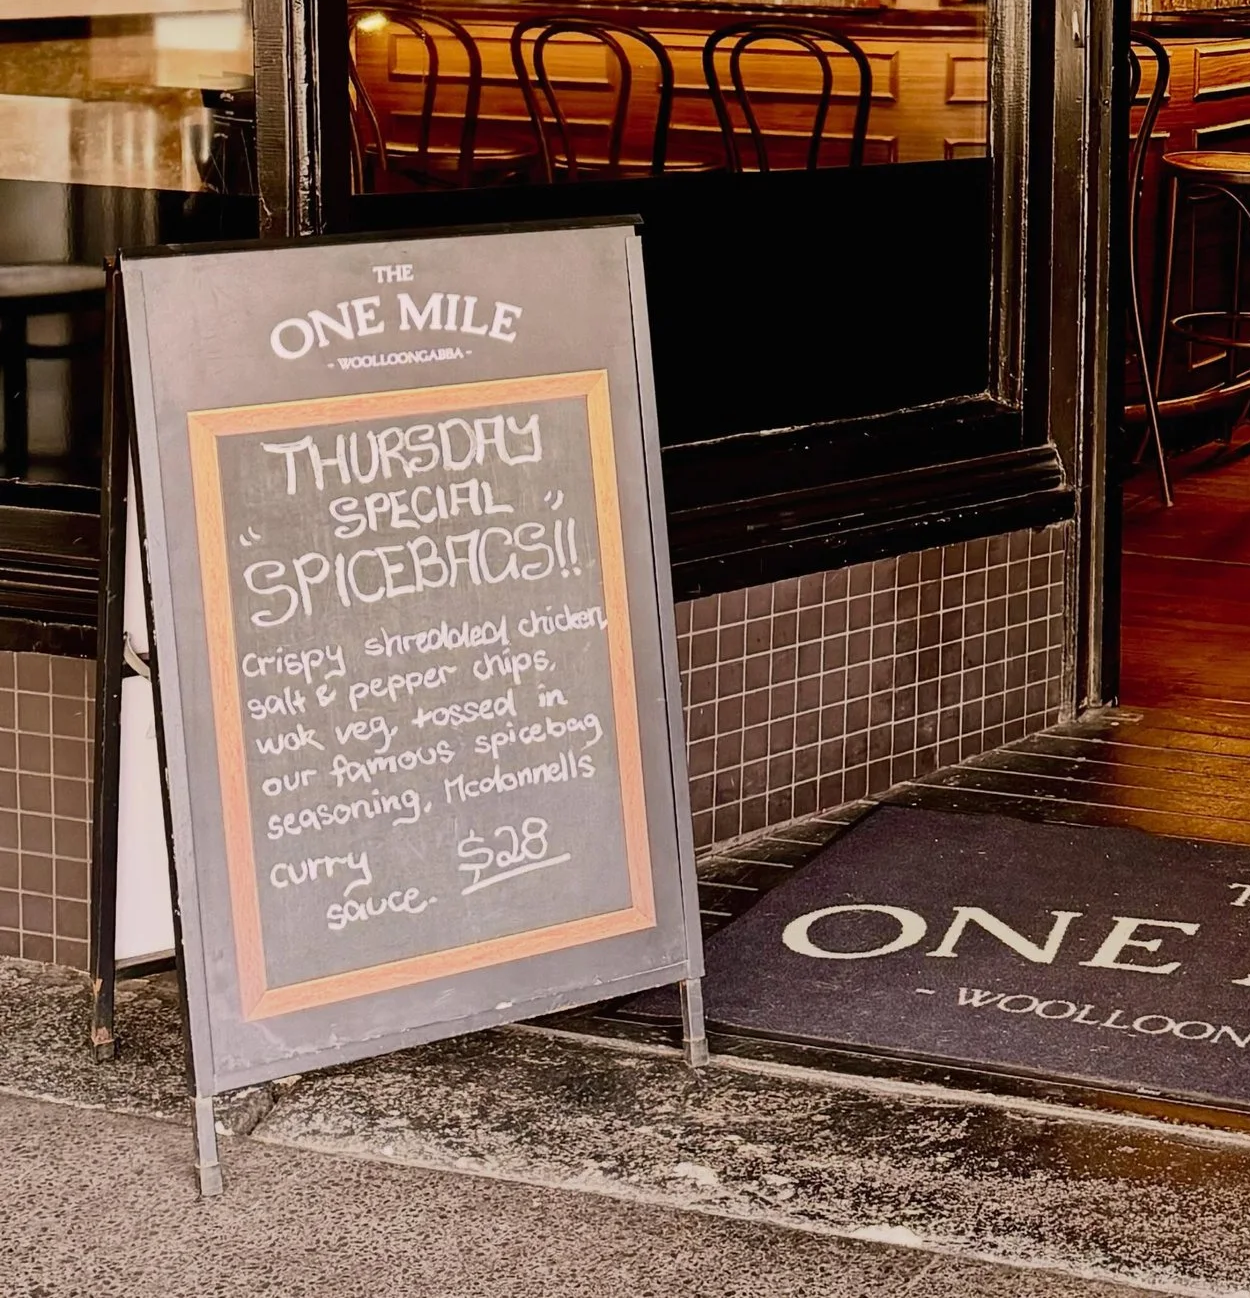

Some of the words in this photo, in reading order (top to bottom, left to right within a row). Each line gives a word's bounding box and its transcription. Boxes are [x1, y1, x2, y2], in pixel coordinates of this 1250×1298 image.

[373, 264, 414, 284] THE
[269, 293, 385, 360] ONE
[398, 292, 524, 343] MILE
[337, 347, 464, 370] WOOLLOONGABBA
[260, 413, 540, 495] THURSDAY
[329, 478, 513, 540] SPECIAL
[365, 620, 508, 658] shredded
[248, 693, 306, 721] salt
[315, 688, 337, 707] &
[348, 663, 456, 713] pepper
[256, 726, 324, 755] wok
[411, 689, 516, 728] tossed
[538, 685, 568, 709] in
[261, 767, 317, 797] our
[330, 740, 456, 787] famous
[475, 712, 604, 760] spicebag
[270, 851, 373, 897] curry
[457, 816, 550, 885] $28
[780, 903, 1201, 974] ONE
